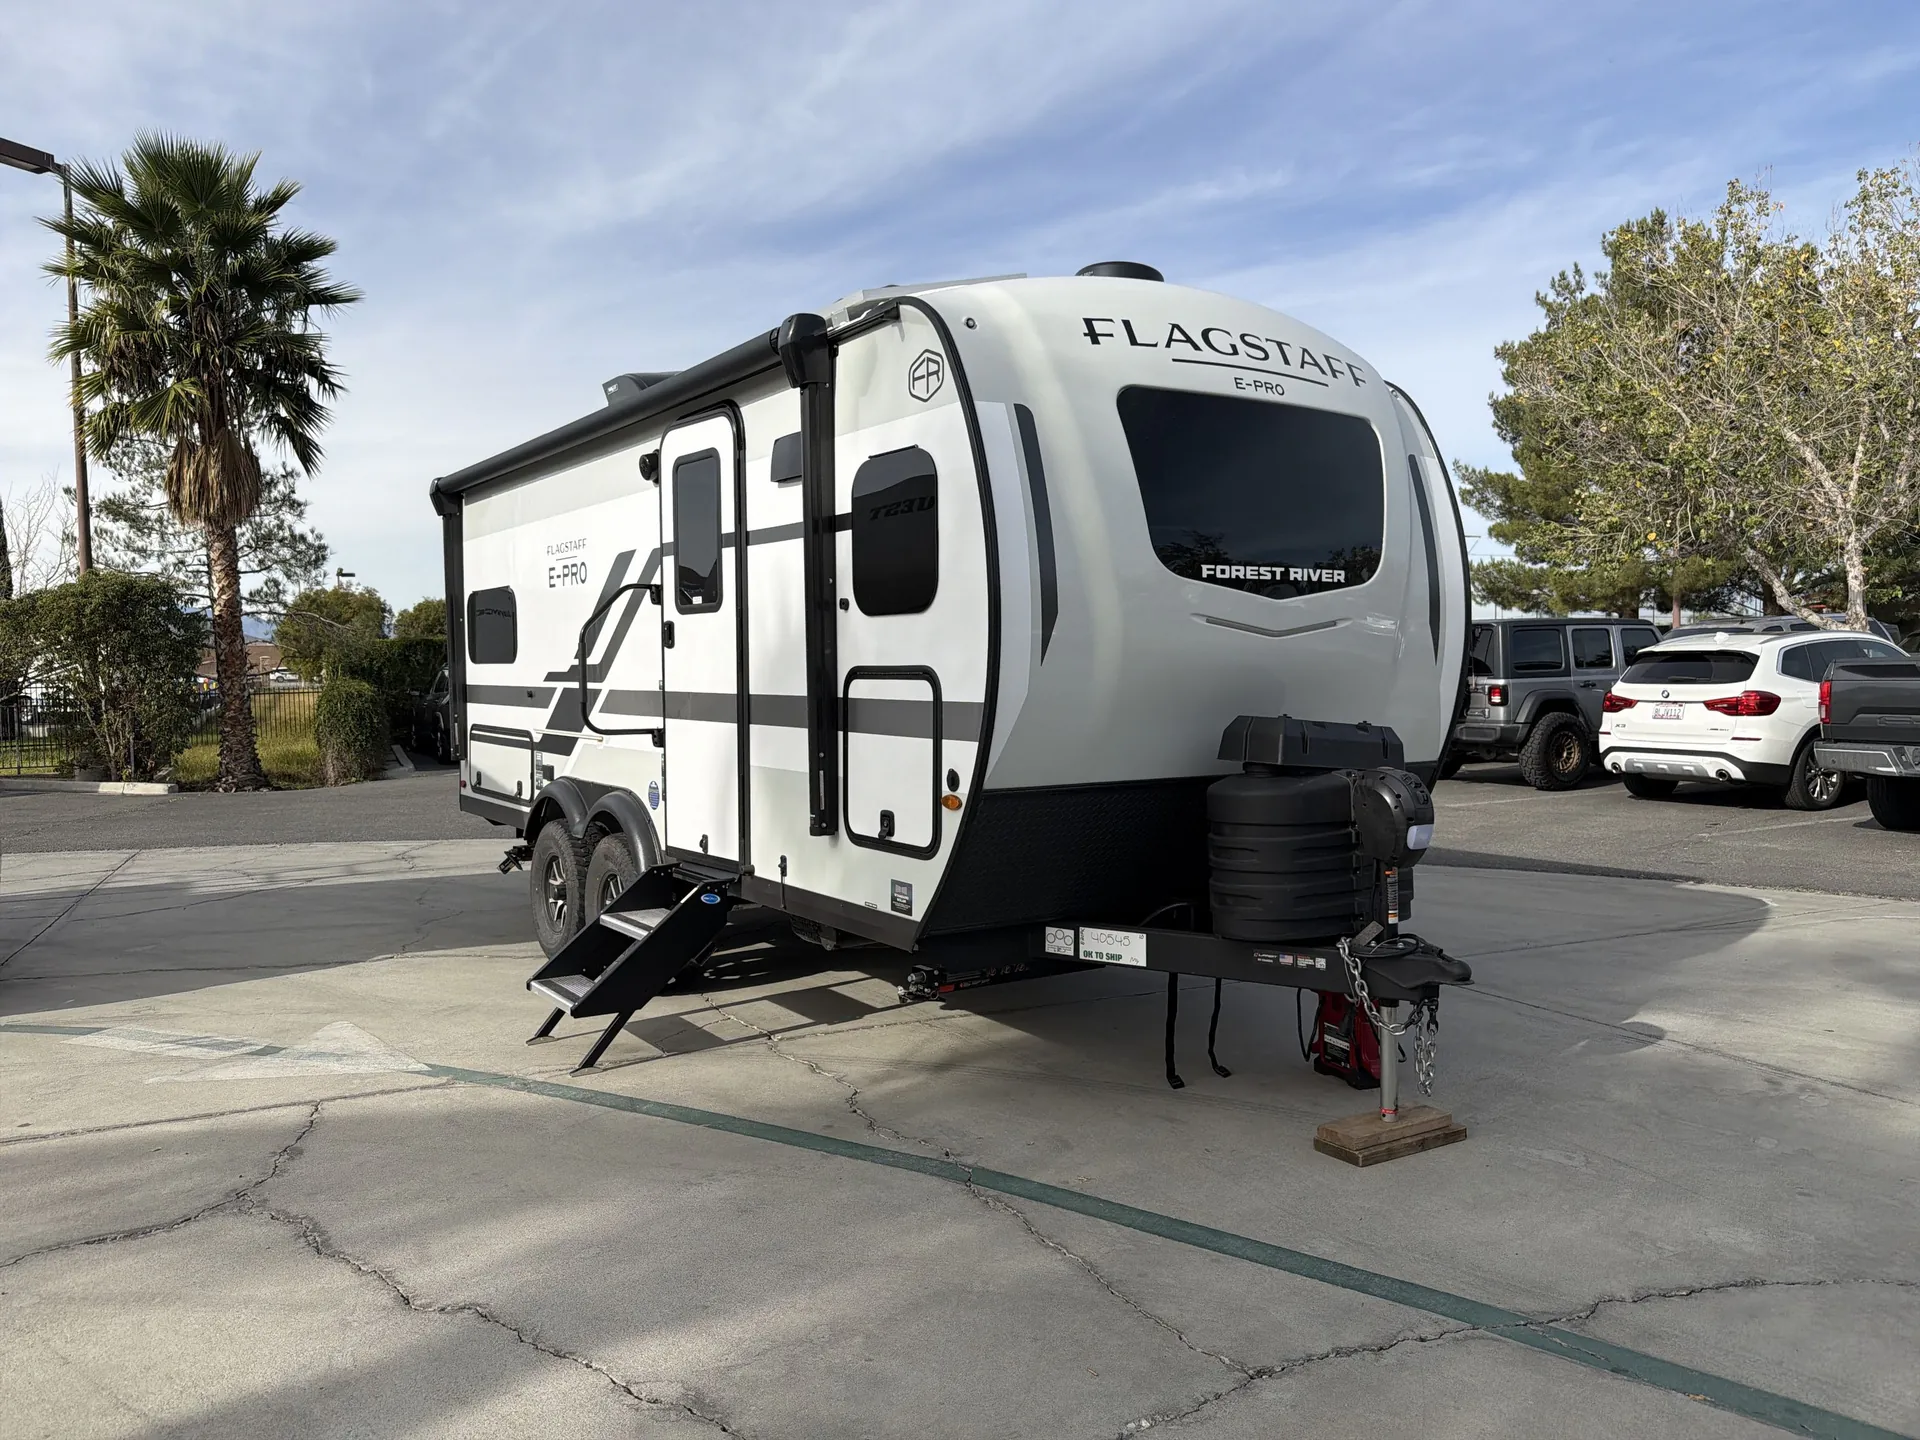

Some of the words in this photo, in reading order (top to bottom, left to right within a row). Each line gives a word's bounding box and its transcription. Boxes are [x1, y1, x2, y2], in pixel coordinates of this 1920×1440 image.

[1082, 317, 1367, 387] FLAGSTAFF
[1234, 376, 1286, 397] E-PRO
[546, 537, 587, 556] FLAGSTAFF
[548, 561, 587, 588] E-PRO
[1200, 564, 1285, 581] FOREST
[1289, 567, 1346, 583] RIVER
[1090, 932, 1131, 947] 40545
[1083, 950, 1094, 959] OK
[1094, 951, 1104, 960] TO
[1105, 952, 1123, 962] SHIP
